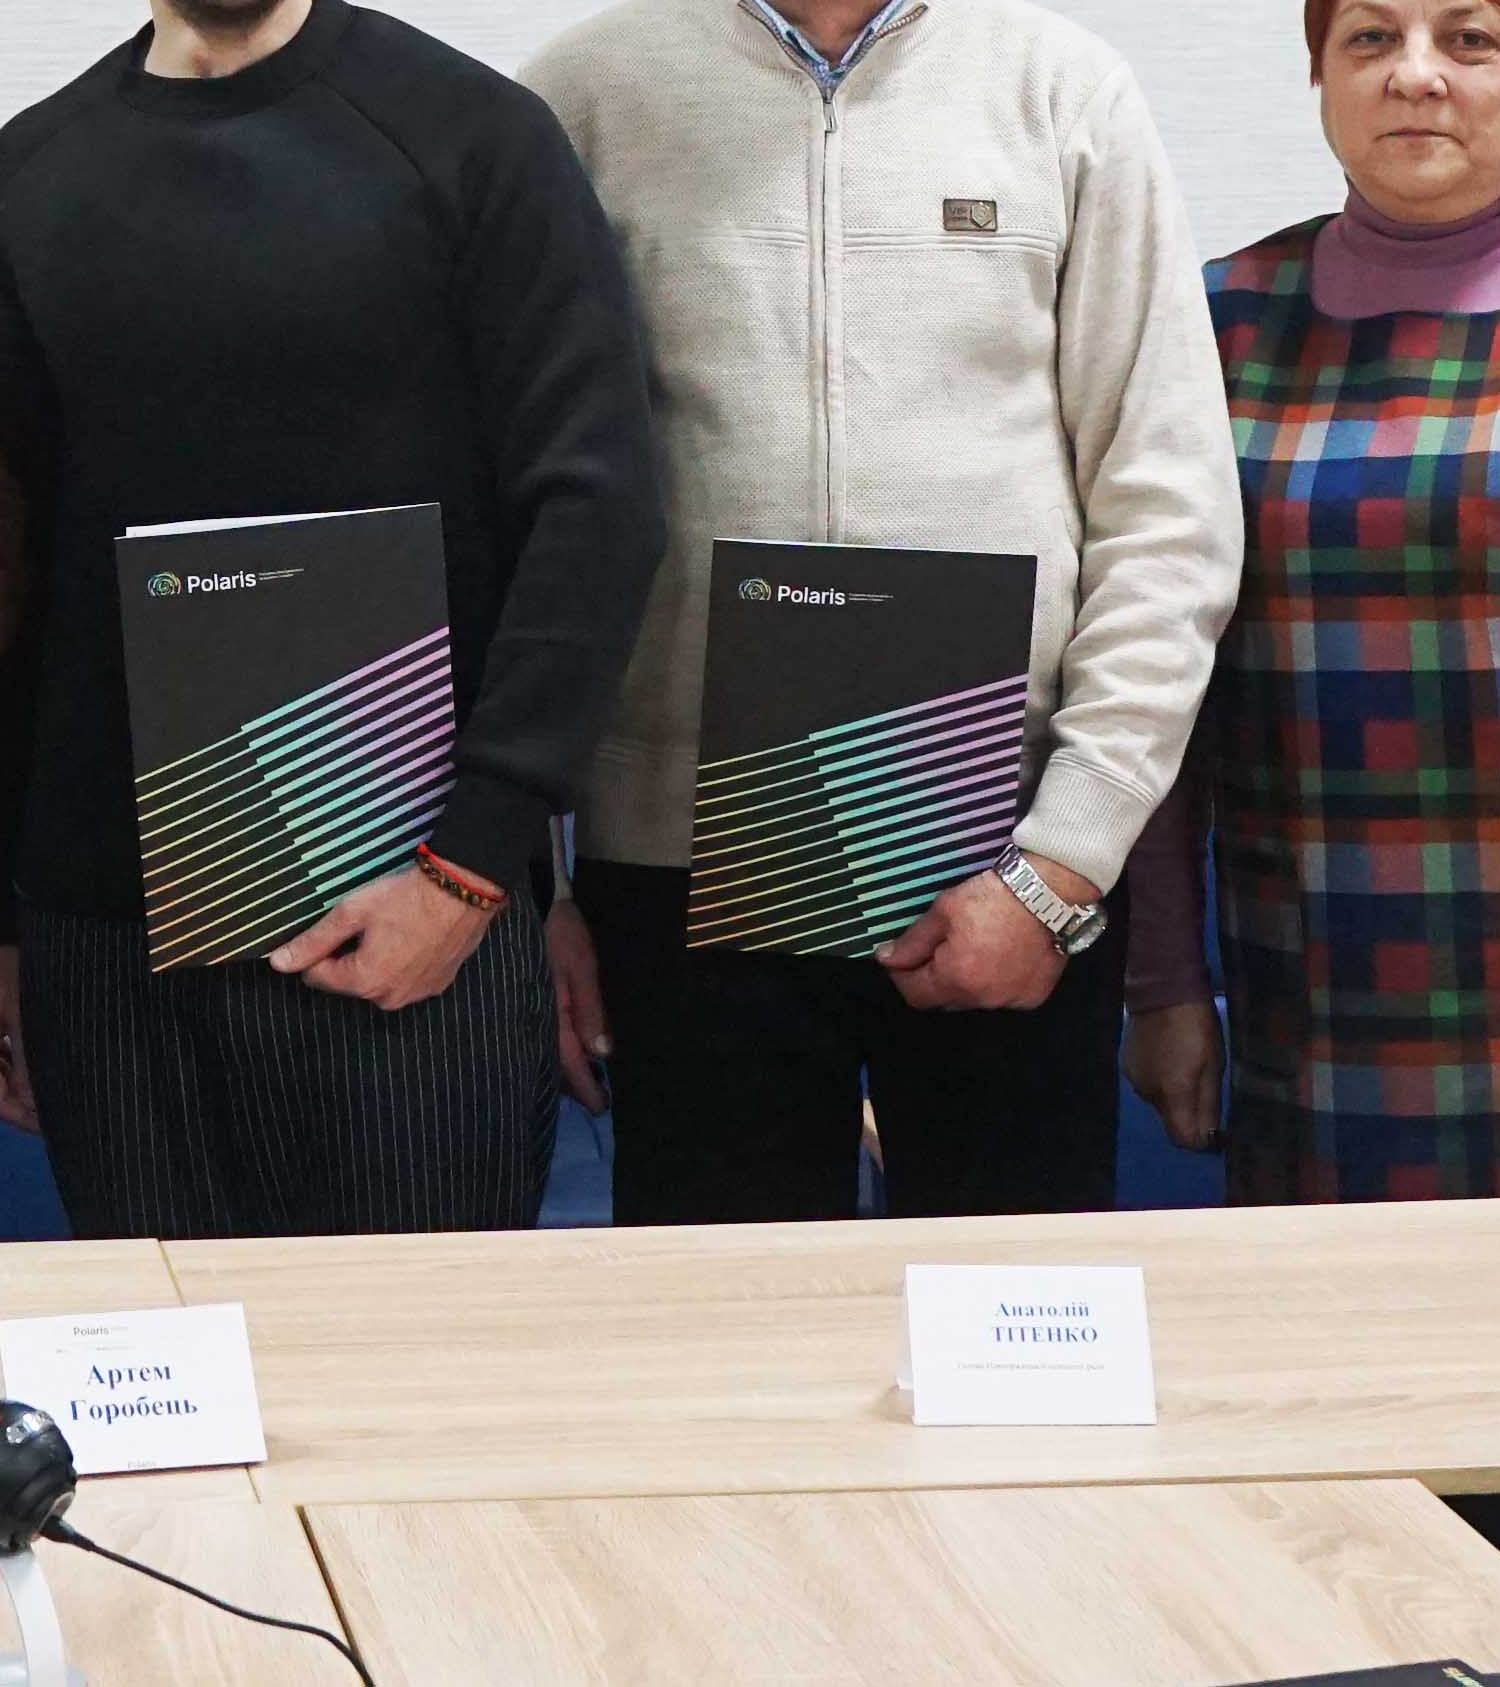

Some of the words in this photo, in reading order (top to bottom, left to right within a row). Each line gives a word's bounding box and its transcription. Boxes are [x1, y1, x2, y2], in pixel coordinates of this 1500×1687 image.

[186, 569, 258, 595] Polaris
[776, 584, 847, 606] Polaris
[995, 1300, 1090, 1318] Анатолій
[992, 1325, 1099, 1344] ТІТЕНКО
[86, 1363, 173, 1390] Артем
[70, 1394, 199, 1425] Горобець
